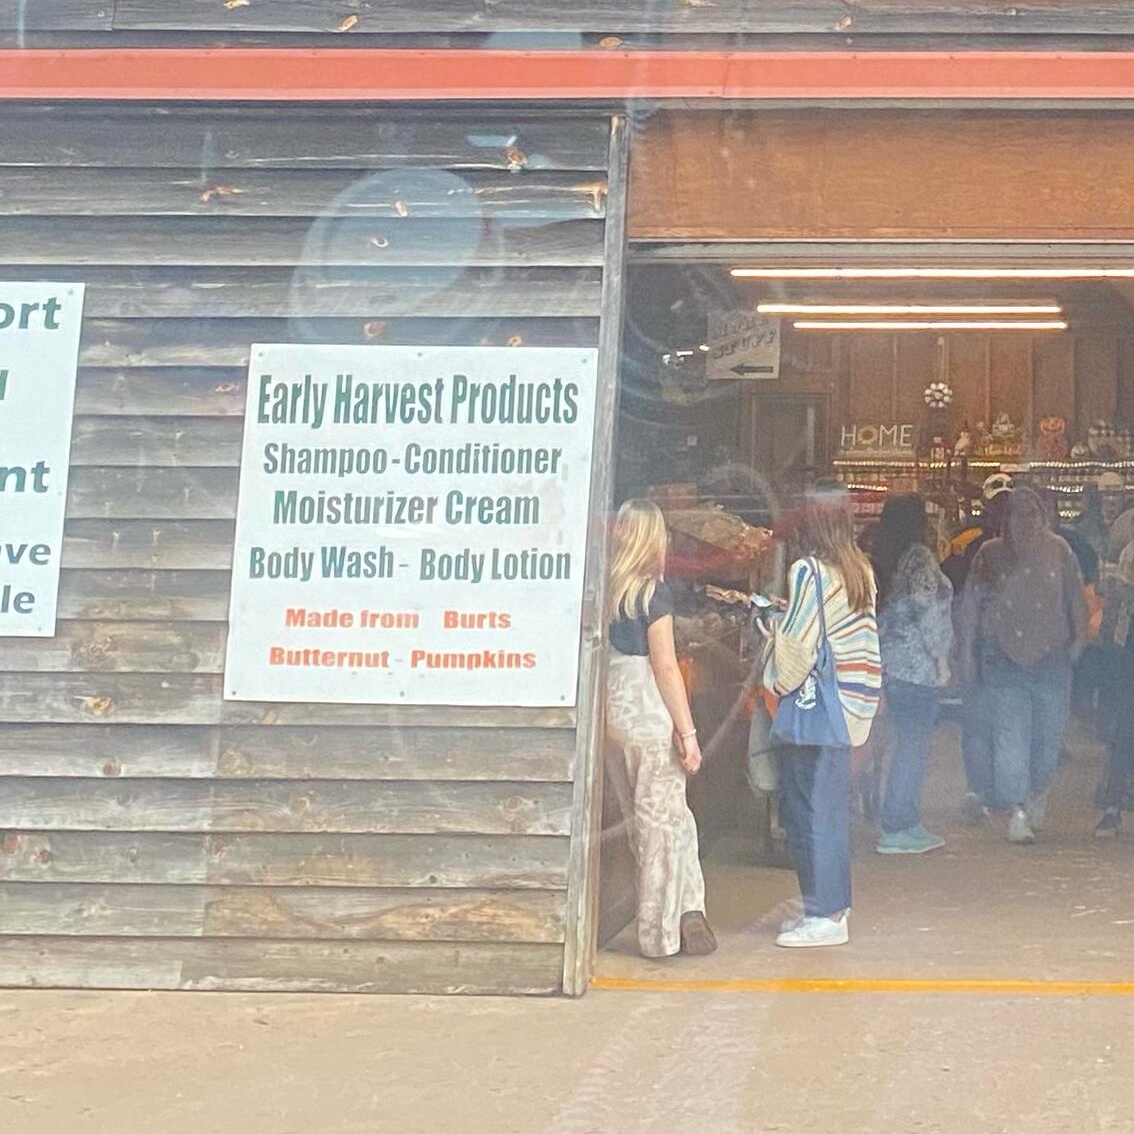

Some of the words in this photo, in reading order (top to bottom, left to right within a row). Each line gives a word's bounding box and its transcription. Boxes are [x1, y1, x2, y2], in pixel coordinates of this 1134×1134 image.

[257, 374, 327, 429] Early
[334, 374, 444, 424] Harvest
[451, 374, 578, 426] Products
[840, 424, 913, 447] HOME
[273, 490, 438, 526] Moisturizer
[445, 490, 540, 526] Cream
[249, 546, 314, 582] Body
[320, 546, 394, 580] Wash
[419, 548, 484, 583] Body
[491, 547, 571, 581] Lotion
[286, 609, 353, 628] Made
[360, 608, 420, 629] from
[443, 610, 511, 629] Burts
[269, 647, 390, 668] Butternut
[410, 649, 537, 671] Pumpkins
